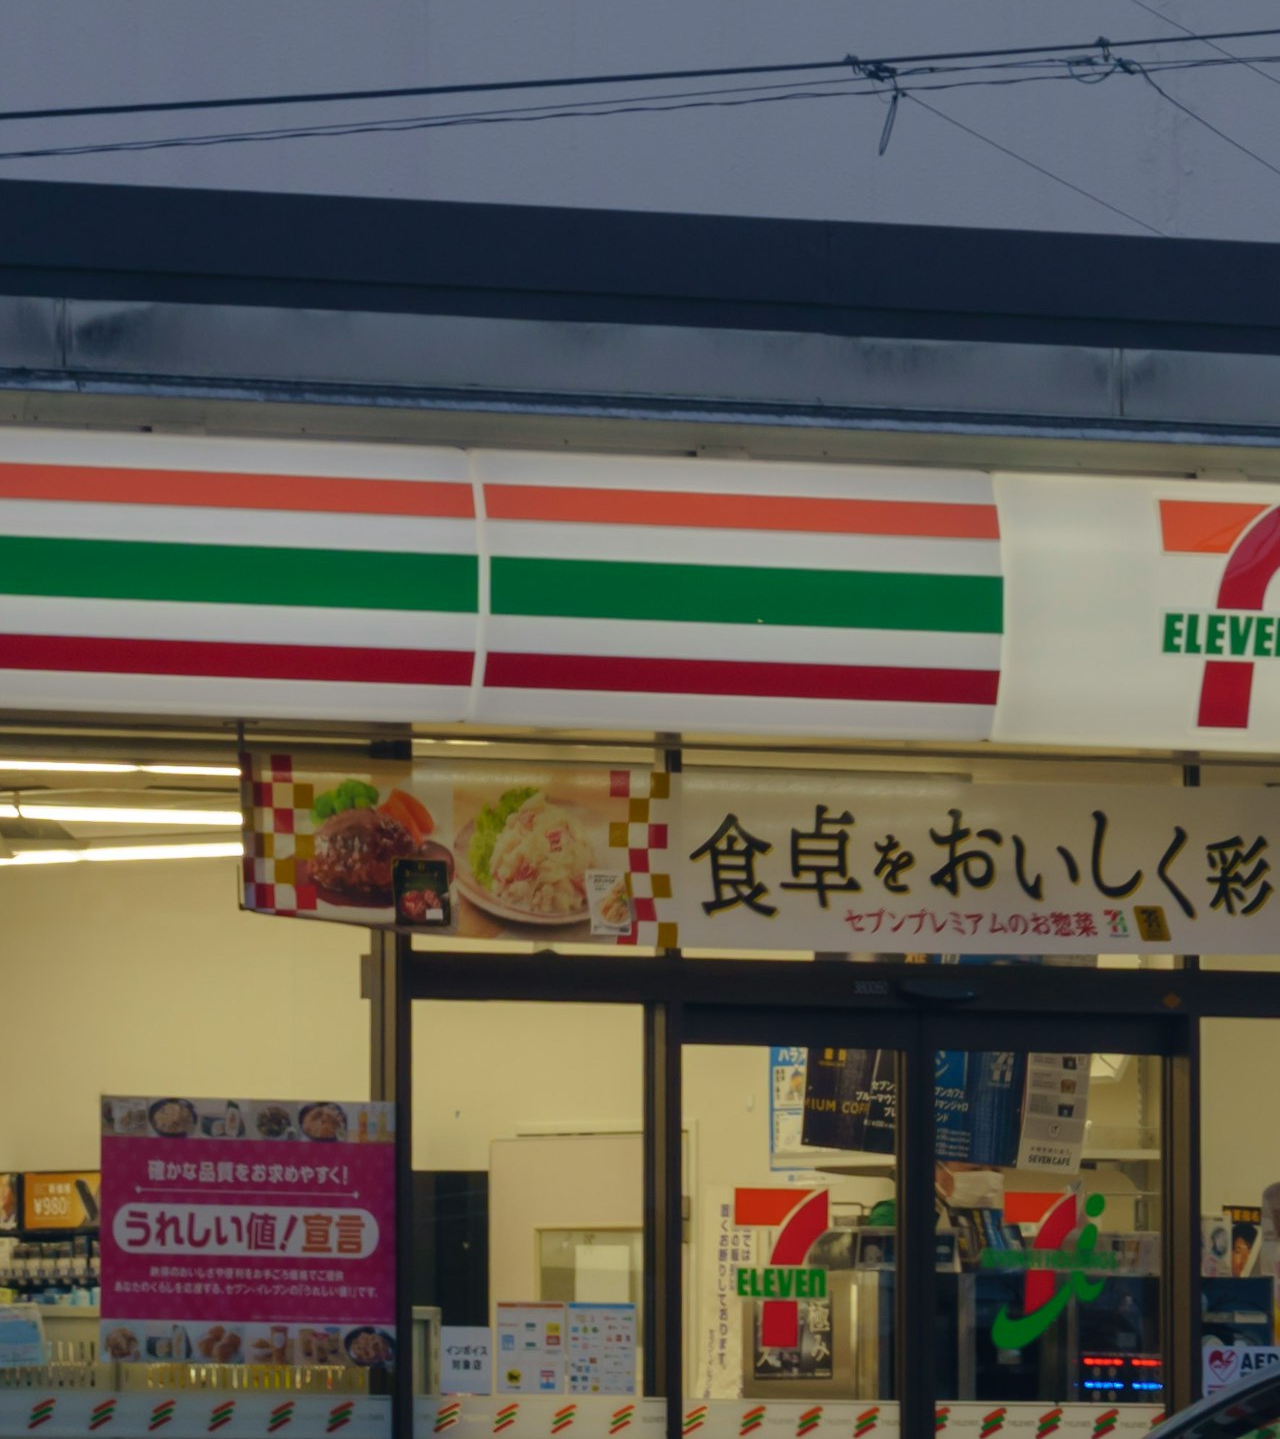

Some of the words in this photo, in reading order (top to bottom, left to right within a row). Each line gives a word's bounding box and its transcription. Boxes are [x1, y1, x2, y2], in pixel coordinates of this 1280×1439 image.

[845, 908, 1099, 937] セブンプレミアムのお惣菜
[446, 1344, 488, 1357] インボイス
